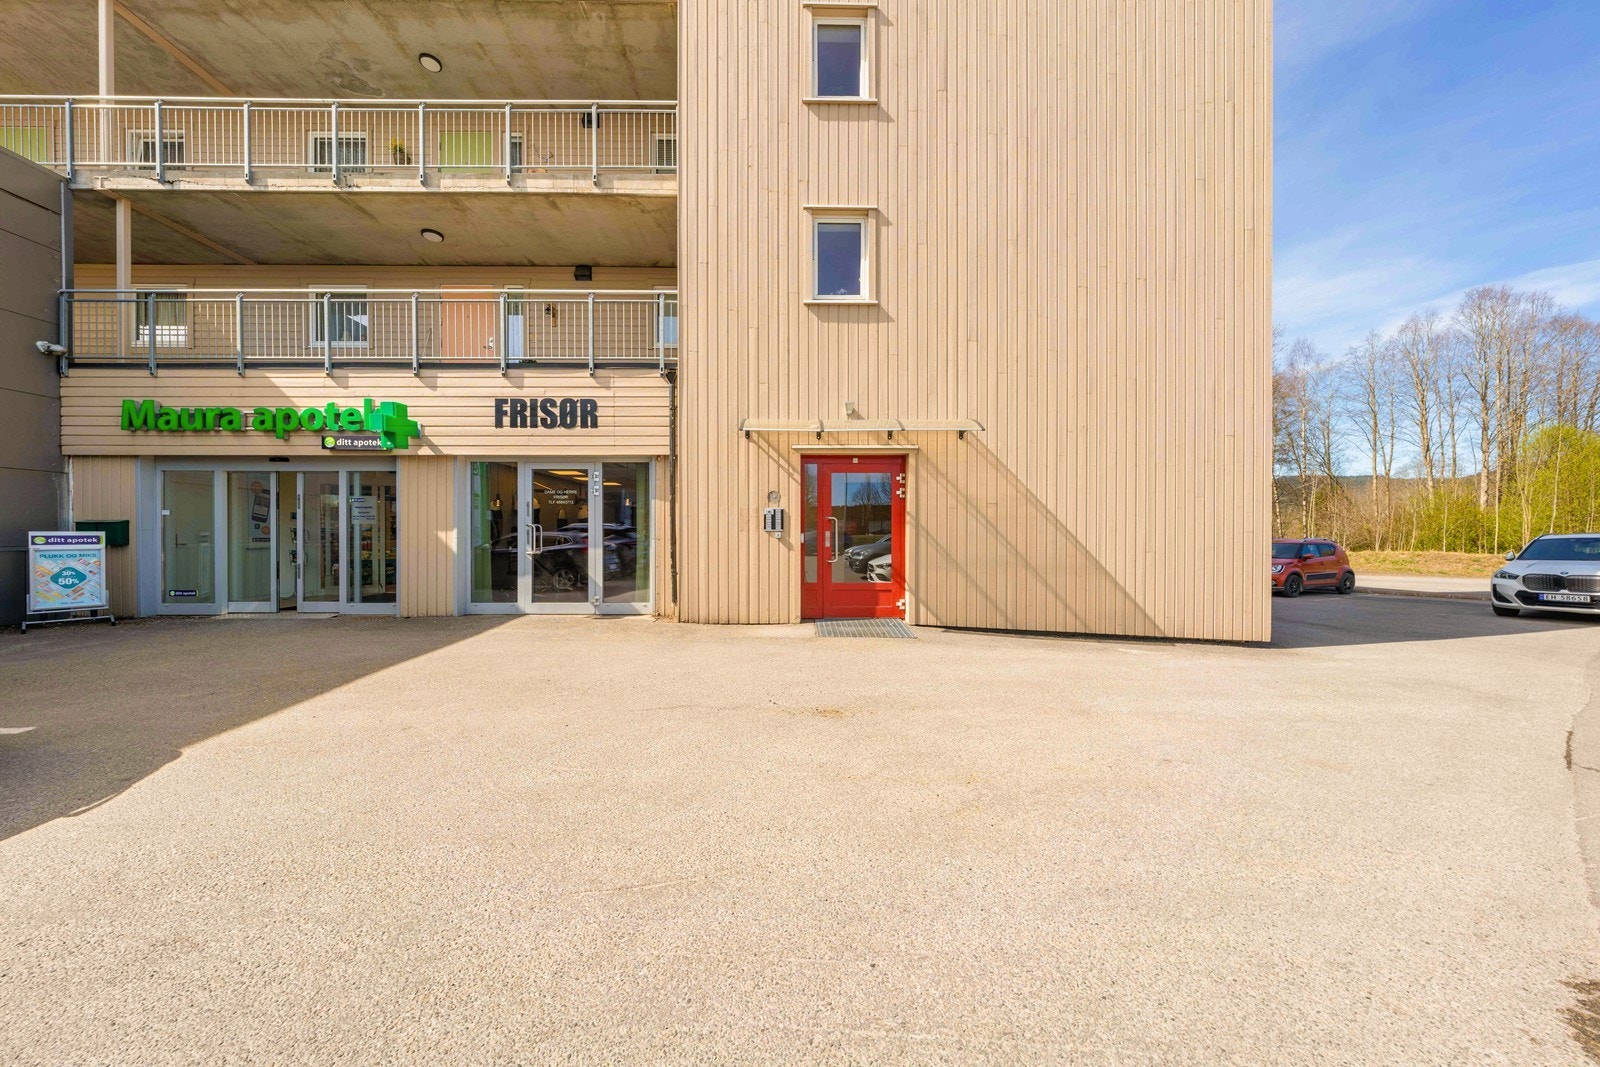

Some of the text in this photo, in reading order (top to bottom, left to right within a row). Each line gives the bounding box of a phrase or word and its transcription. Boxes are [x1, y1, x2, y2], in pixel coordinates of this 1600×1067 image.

[120, 399, 244, 431] Maura
[494, 398, 599, 429] FRISØR
[336, 437, 382, 448] ditt apotek
[58, 577, 80, 585] 50%
